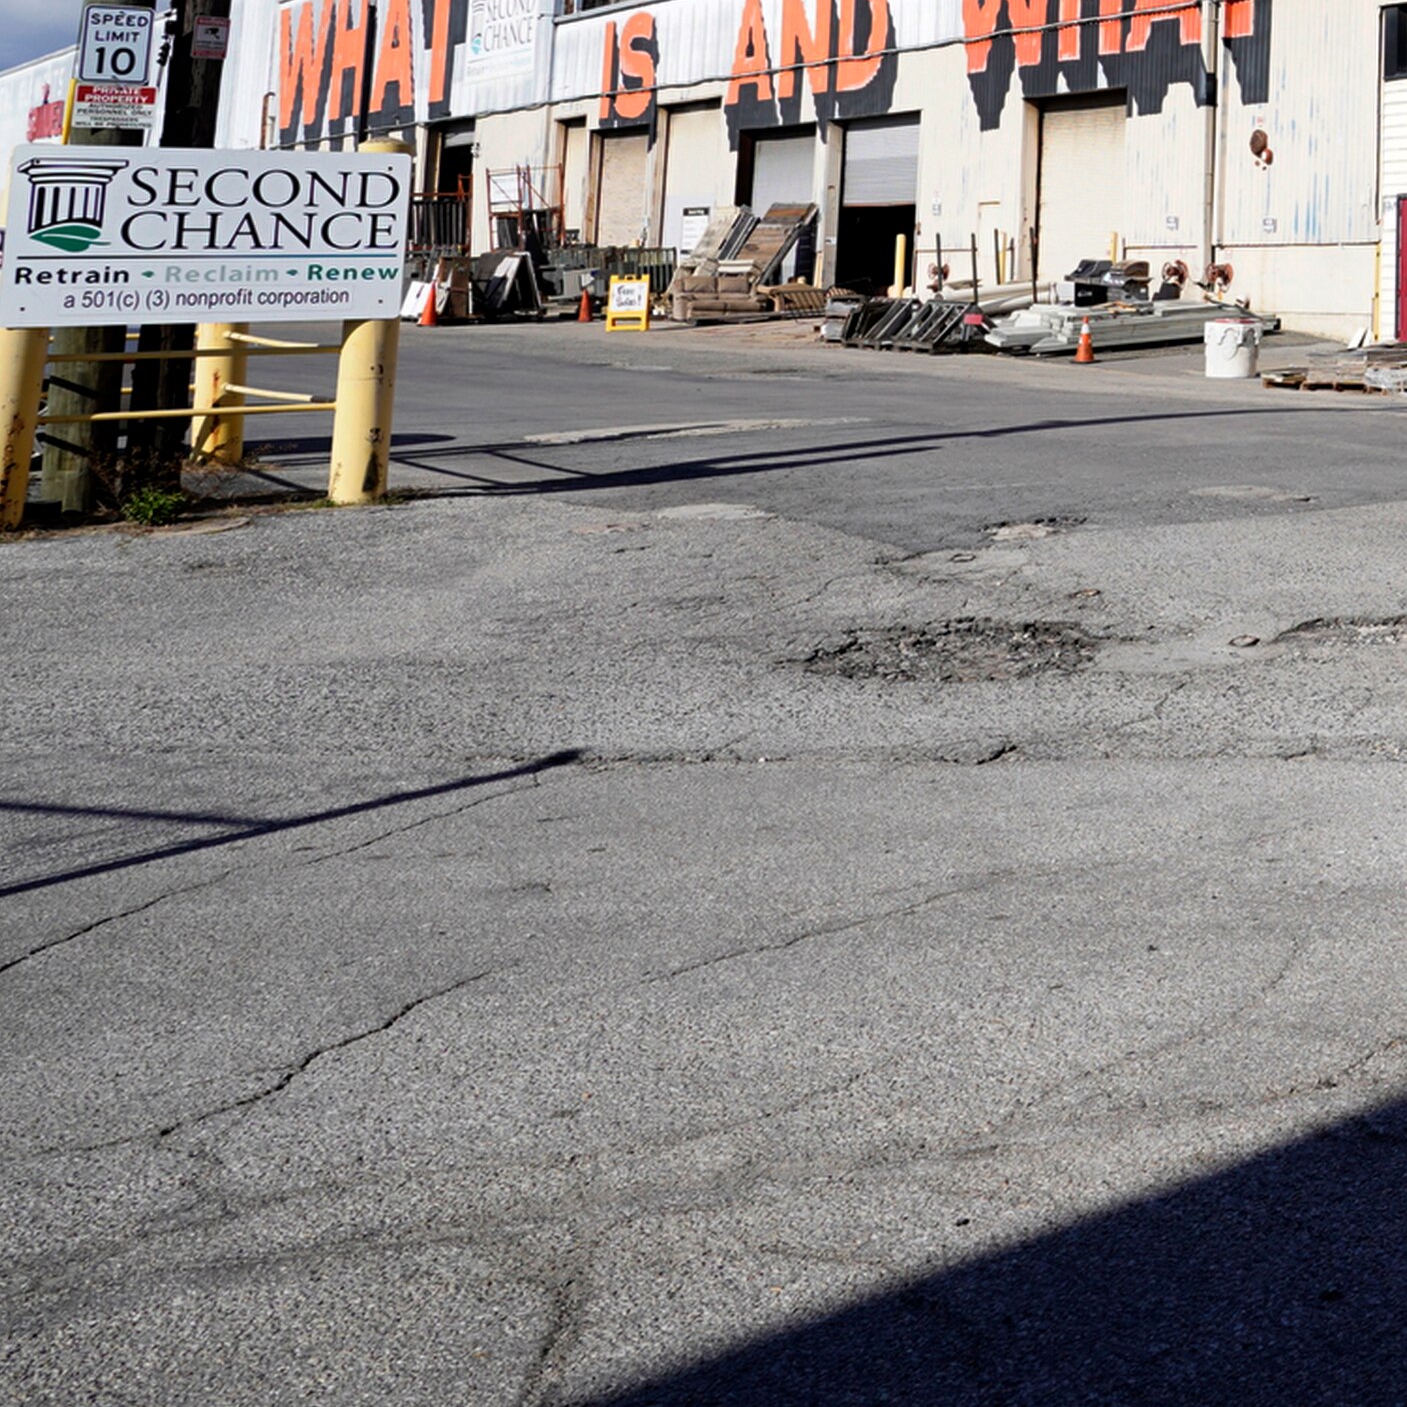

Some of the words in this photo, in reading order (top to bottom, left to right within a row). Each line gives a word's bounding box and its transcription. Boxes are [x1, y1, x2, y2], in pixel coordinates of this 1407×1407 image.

[91, 12, 148, 27] SPEED
[95, 30, 140, 42] LIMIT
[483, 15, 533, 52] CHANCE
[95, 46, 136, 75] 10
[600, 11, 657, 120] IS
[84, 94, 149, 103] PROPERTY
[92, 85, 141, 95] PRIVATE
[76, 108, 128, 116] PERSONNEL
[126, 166, 401, 208] SECOND
[120, 210, 400, 251] CHANCE
[15, 265, 130, 285] Retrain
[164, 263, 279, 283] Reclaim
[307, 263, 399, 281] Renew
[63, 296, 75, 309] a
[81, 290, 140, 311] 501(c)
[146, 289, 170, 310] (3)
[176, 287, 253, 308] nonprofit
[258, 288, 349, 307] corporation
